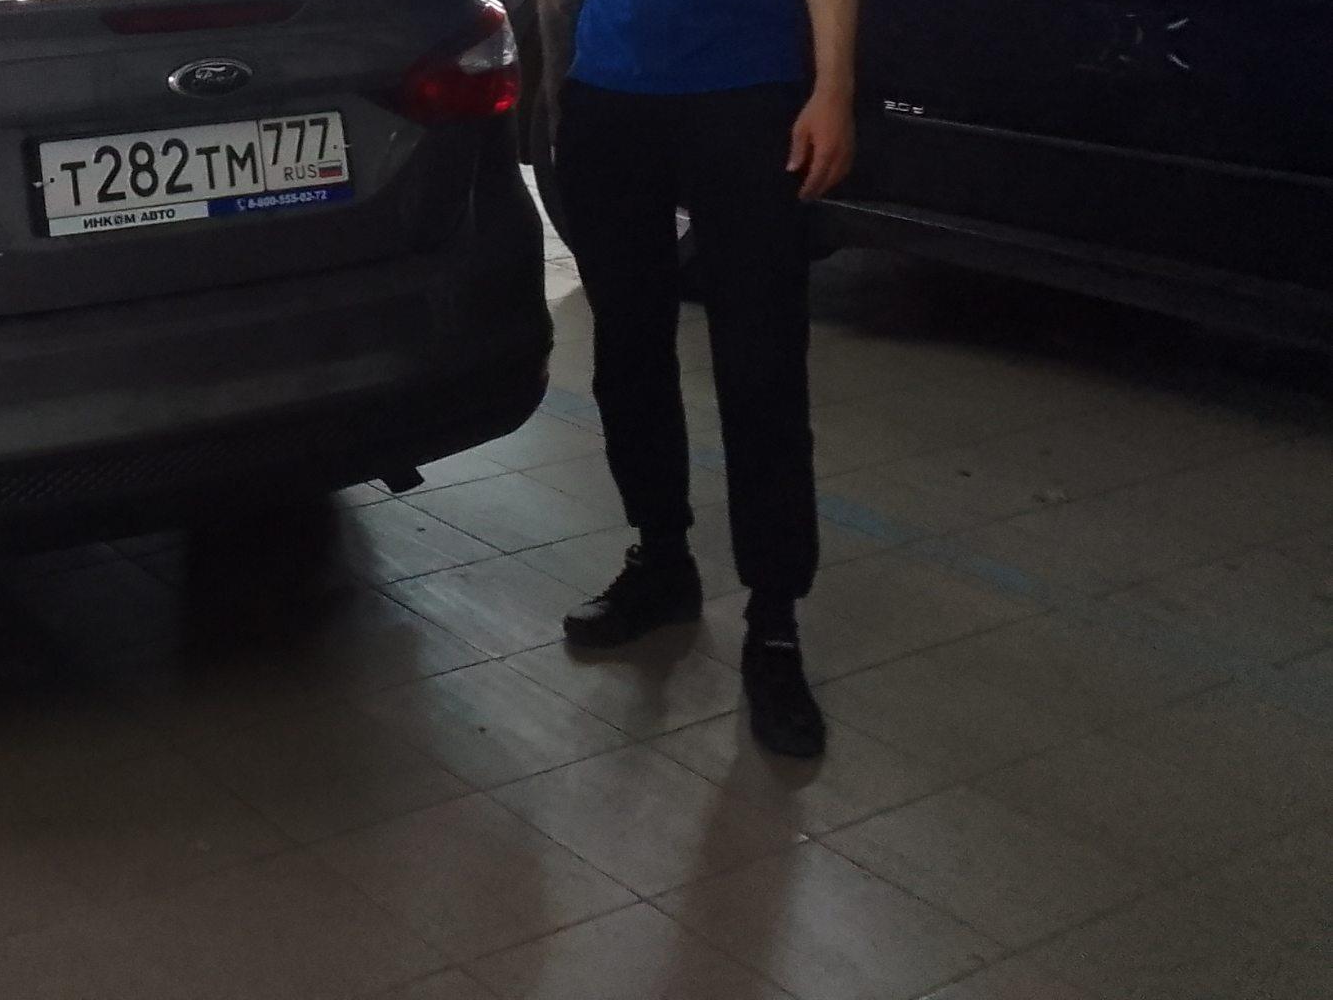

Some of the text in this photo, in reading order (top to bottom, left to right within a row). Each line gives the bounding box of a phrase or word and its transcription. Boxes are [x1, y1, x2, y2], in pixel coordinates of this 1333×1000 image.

[262, 116, 330, 167] 777
[283, 163, 317, 182] RUS
[139, 208, 177, 222] АВТО
